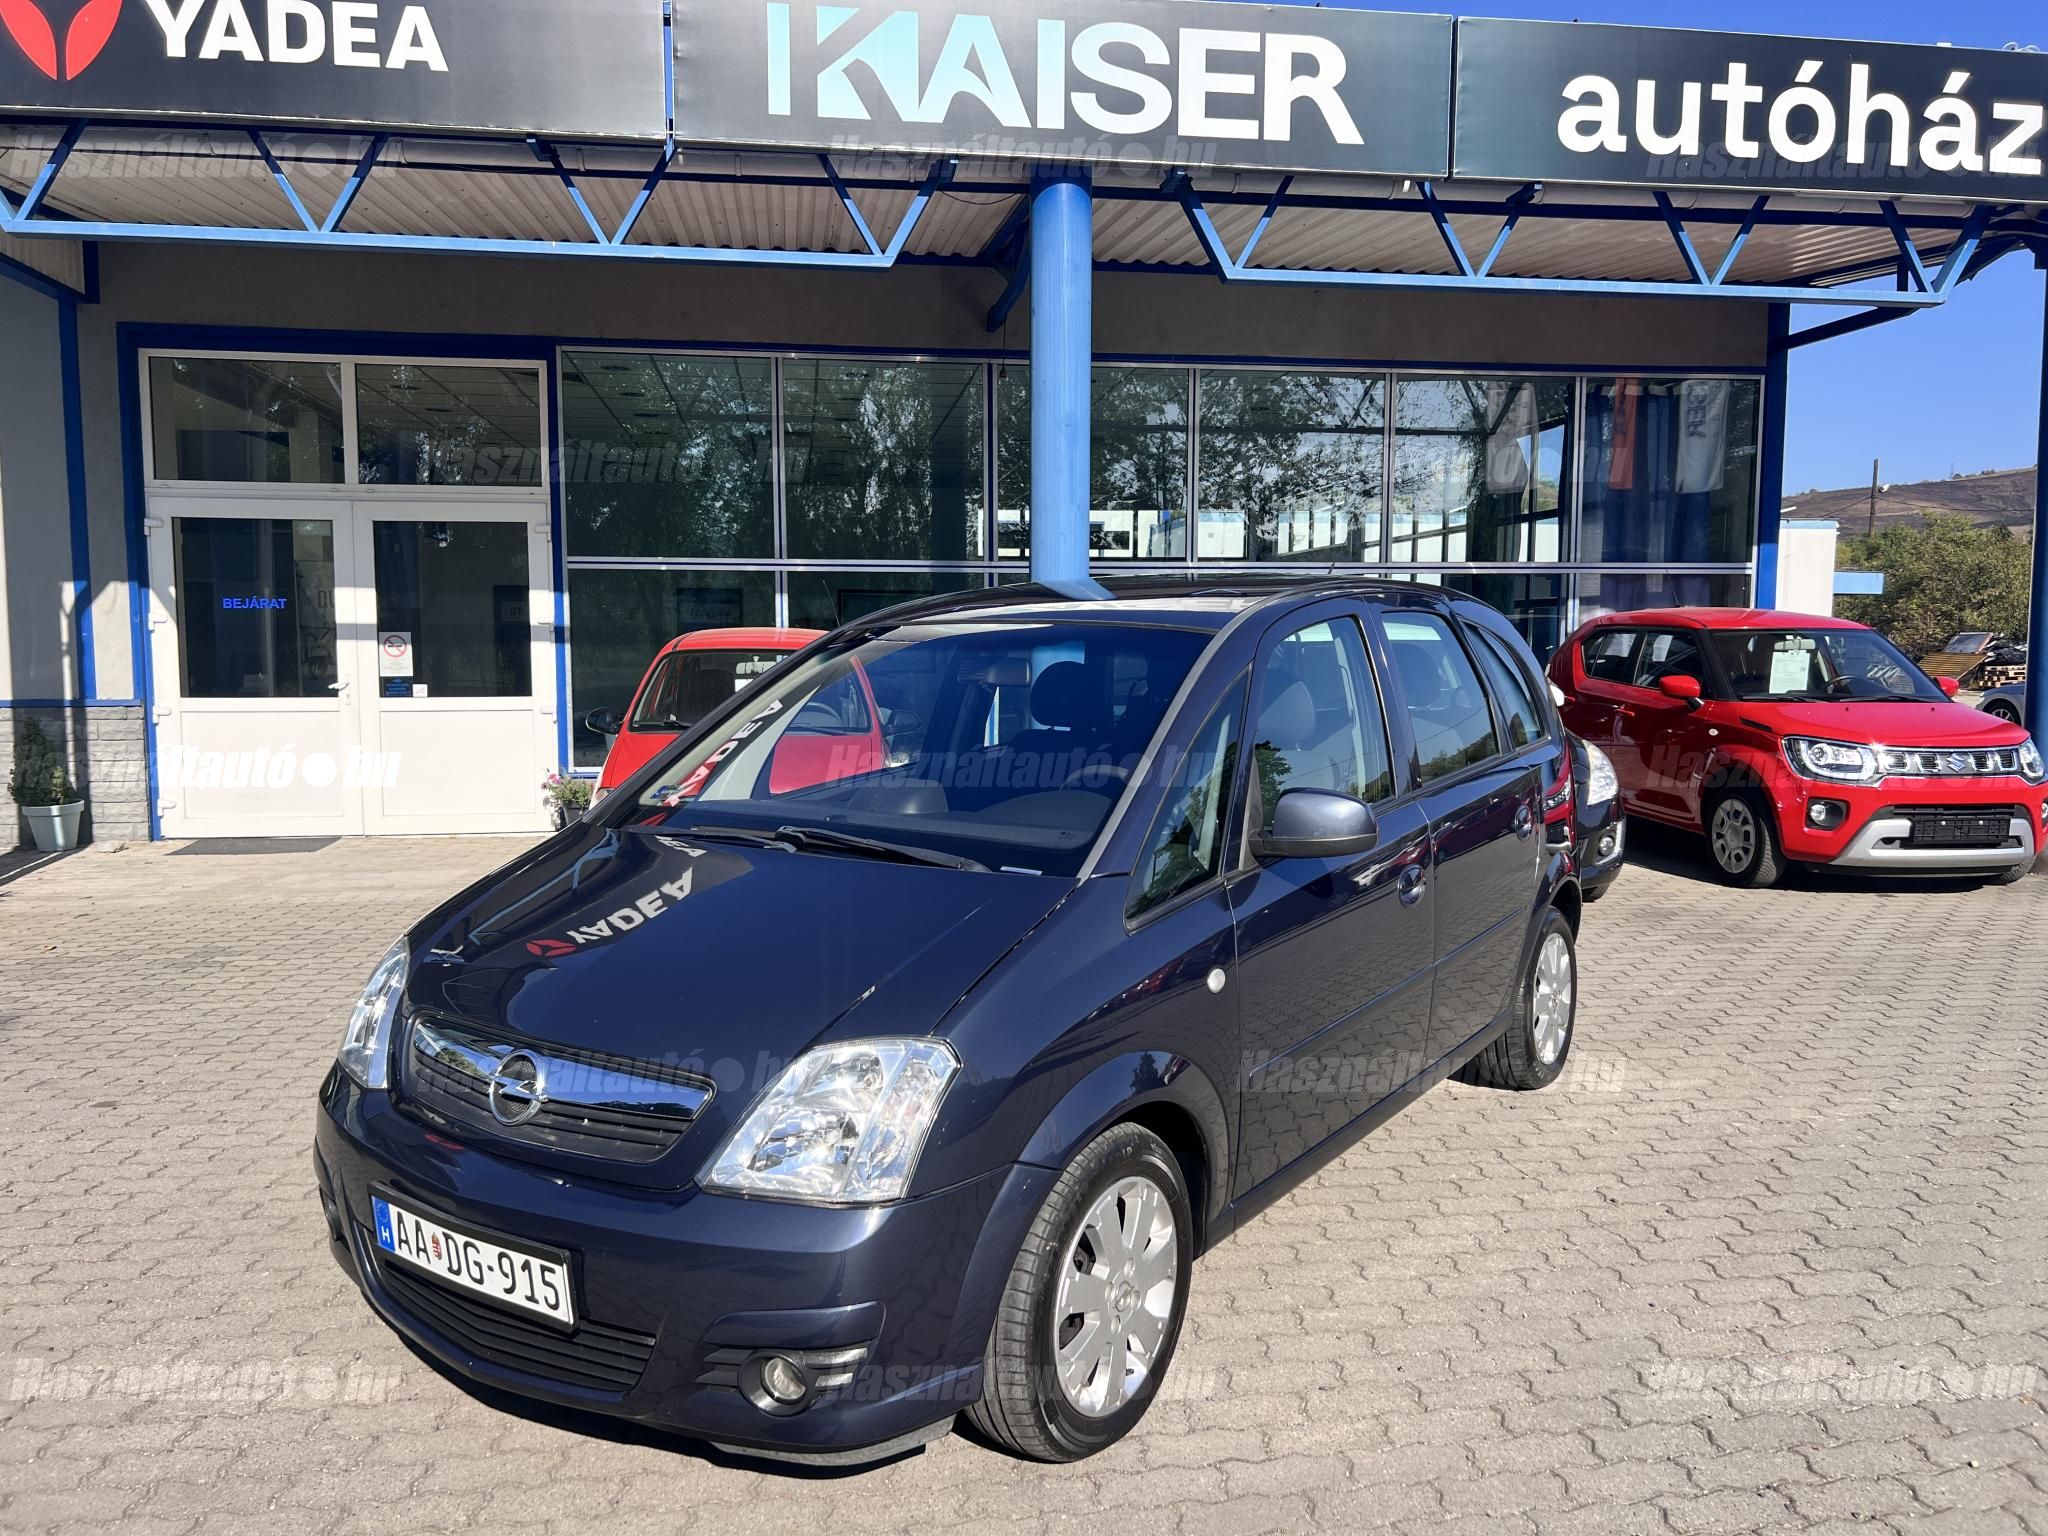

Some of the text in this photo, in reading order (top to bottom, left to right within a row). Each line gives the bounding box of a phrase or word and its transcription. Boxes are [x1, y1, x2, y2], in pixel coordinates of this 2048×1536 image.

[145, 0, 449, 72] YADEA
[1557, 60, 2044, 176] autóház
[222, 596, 288, 609] BEJÁRAT
[381, 1211, 560, 1311] H AA DG-915
